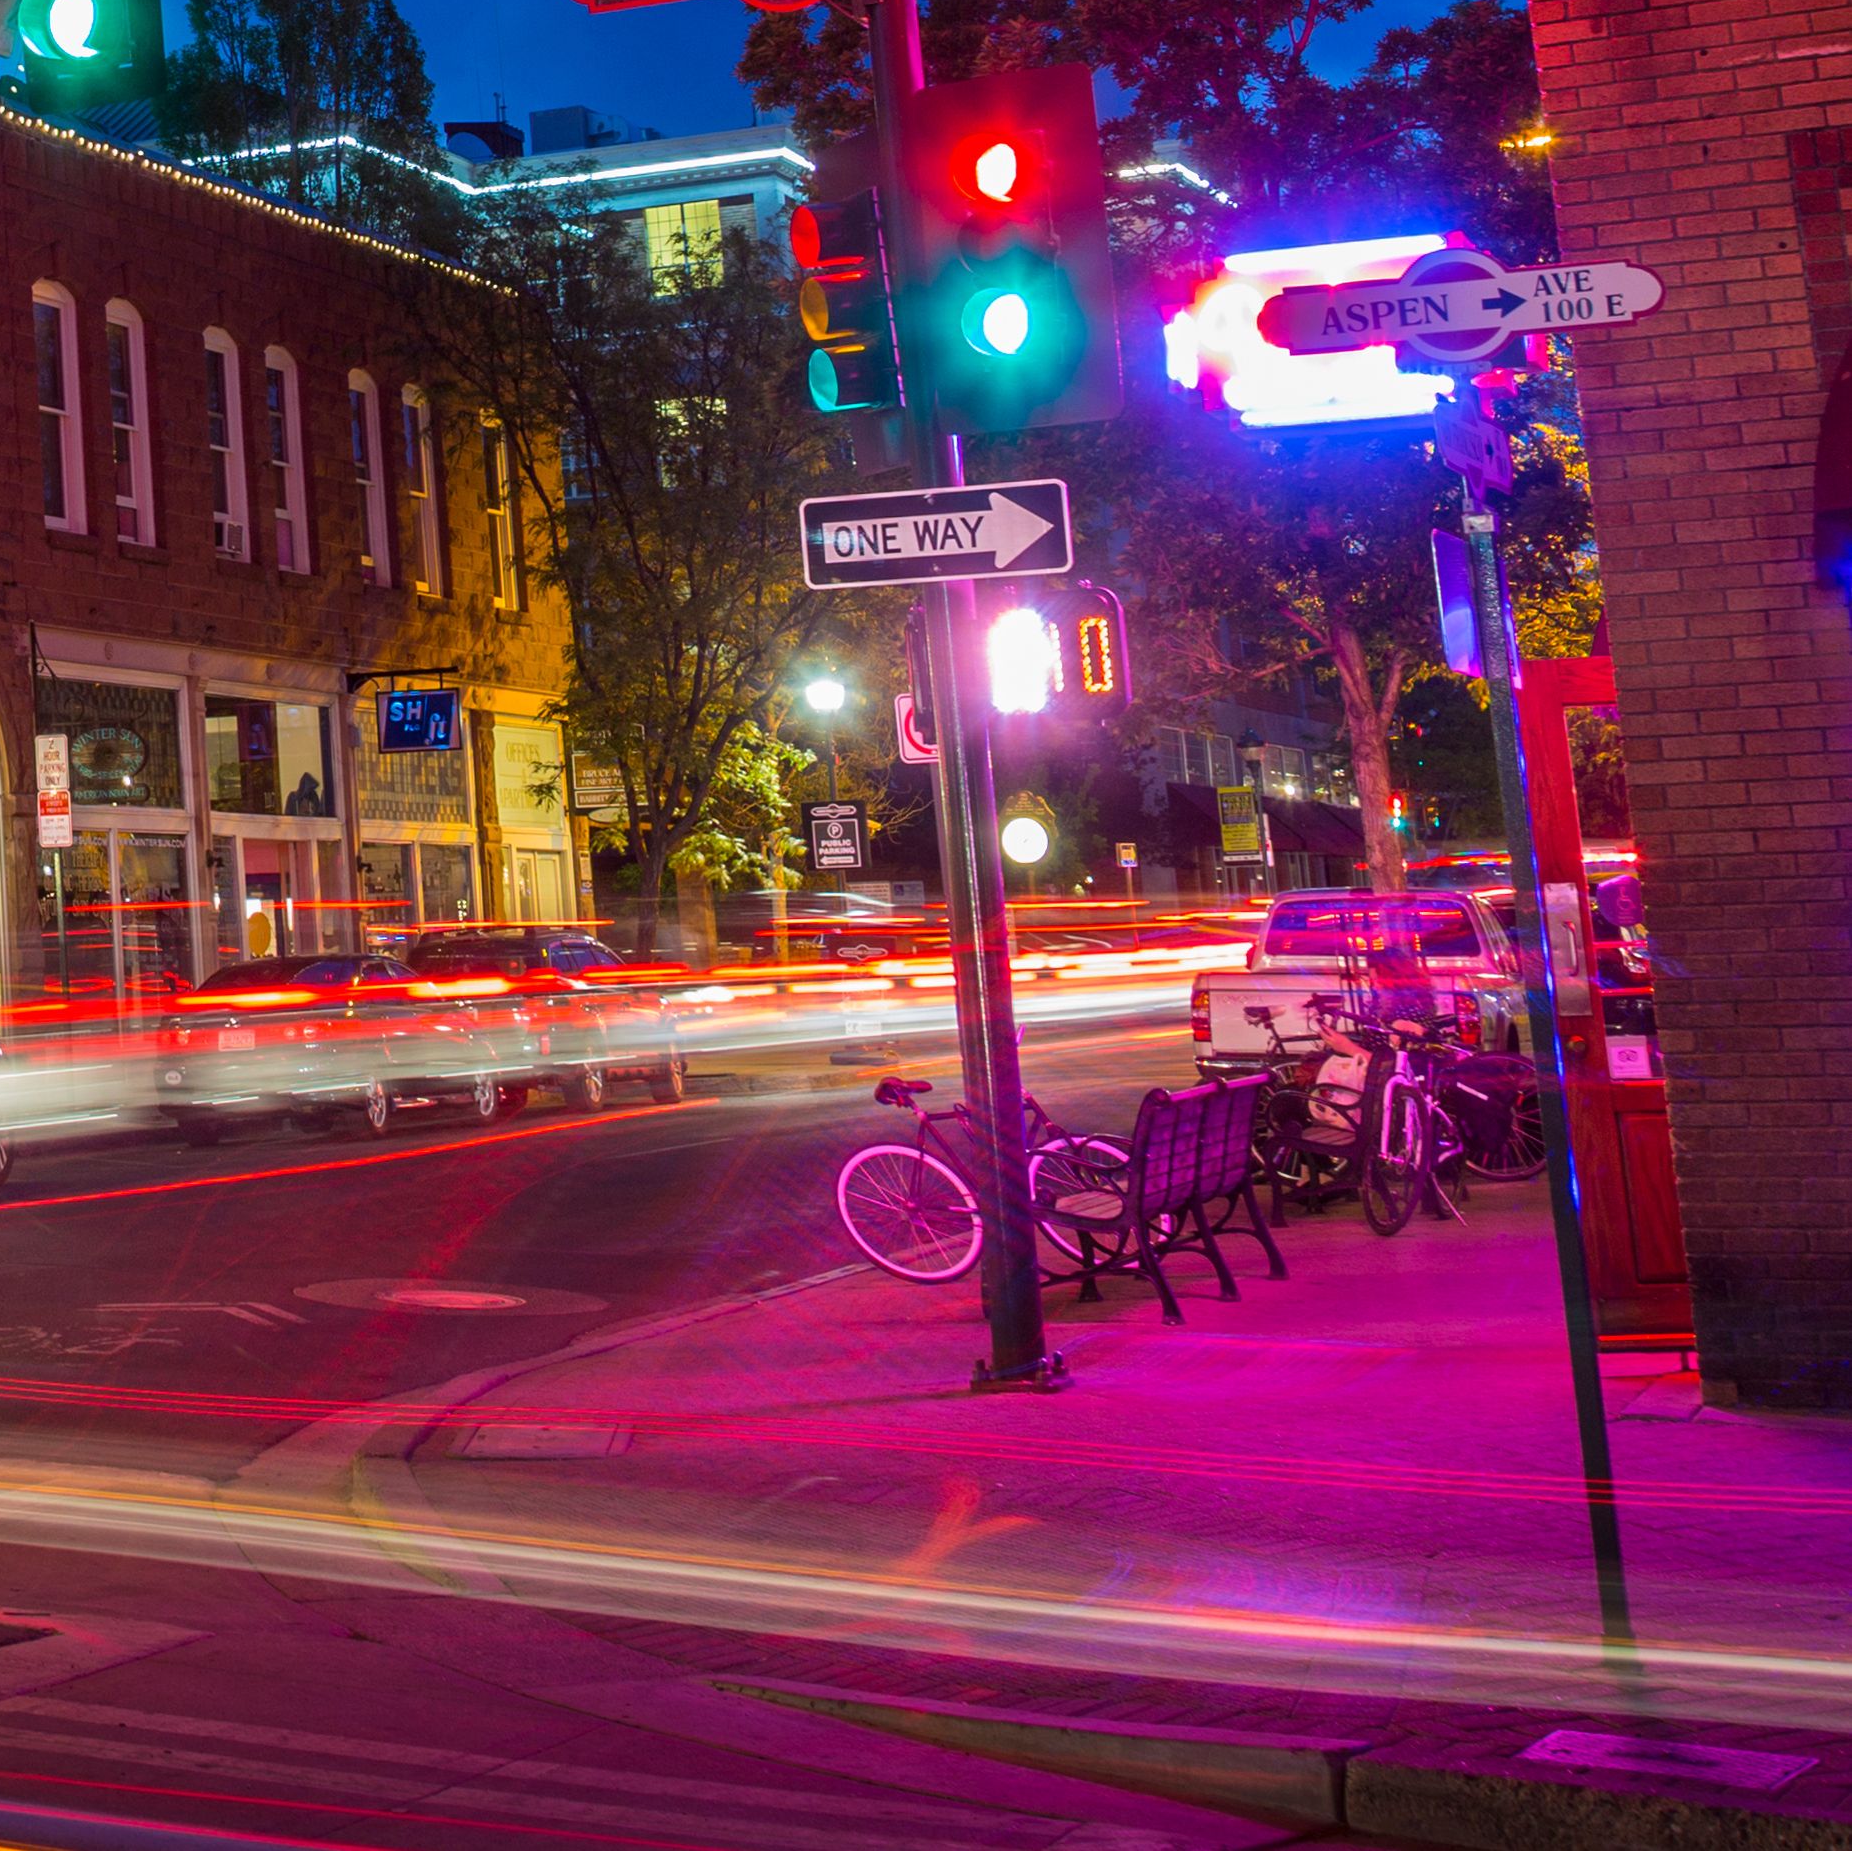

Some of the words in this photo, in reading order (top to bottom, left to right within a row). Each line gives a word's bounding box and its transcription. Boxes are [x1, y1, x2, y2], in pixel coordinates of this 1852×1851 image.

[1321, 293, 1450, 336] ASPEN
[1533, 269, 1594, 298] AVE
[1541, 296, 1593, 323] 100
[1605, 293, 1626, 318] E
[833, 522, 902, 558] ONE
[913, 515, 985, 553] WAY
[72, 727, 117, 753] WINTER
[119, 728, 143, 749] SUN
[505, 741, 541, 763] OFFICES
[40, 764, 66, 774] PARKING
[819, 847, 856, 855] PARKING
[820, 839, 852, 847] PUBLIC
